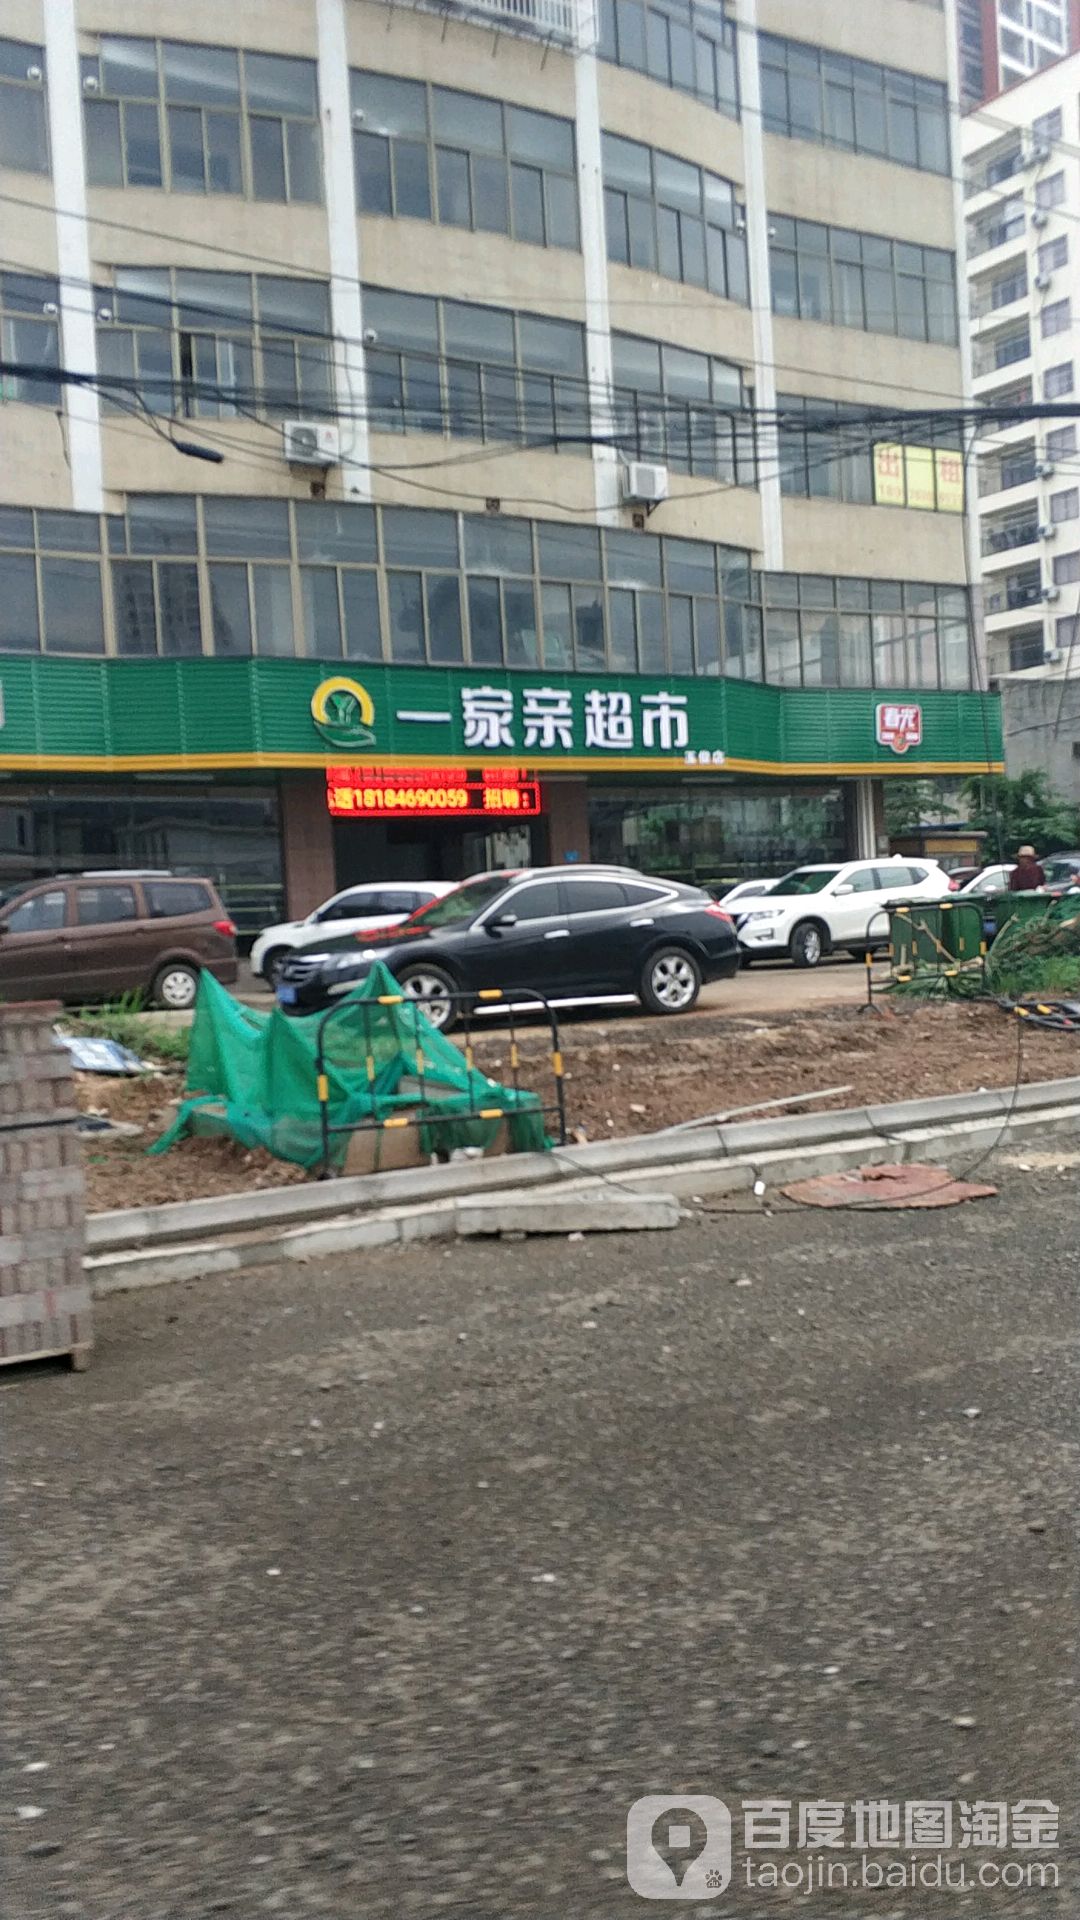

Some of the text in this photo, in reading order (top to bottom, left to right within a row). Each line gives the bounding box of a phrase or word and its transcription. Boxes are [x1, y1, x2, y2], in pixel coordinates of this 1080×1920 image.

[397, 686, 689, 749] 一家亲超市
